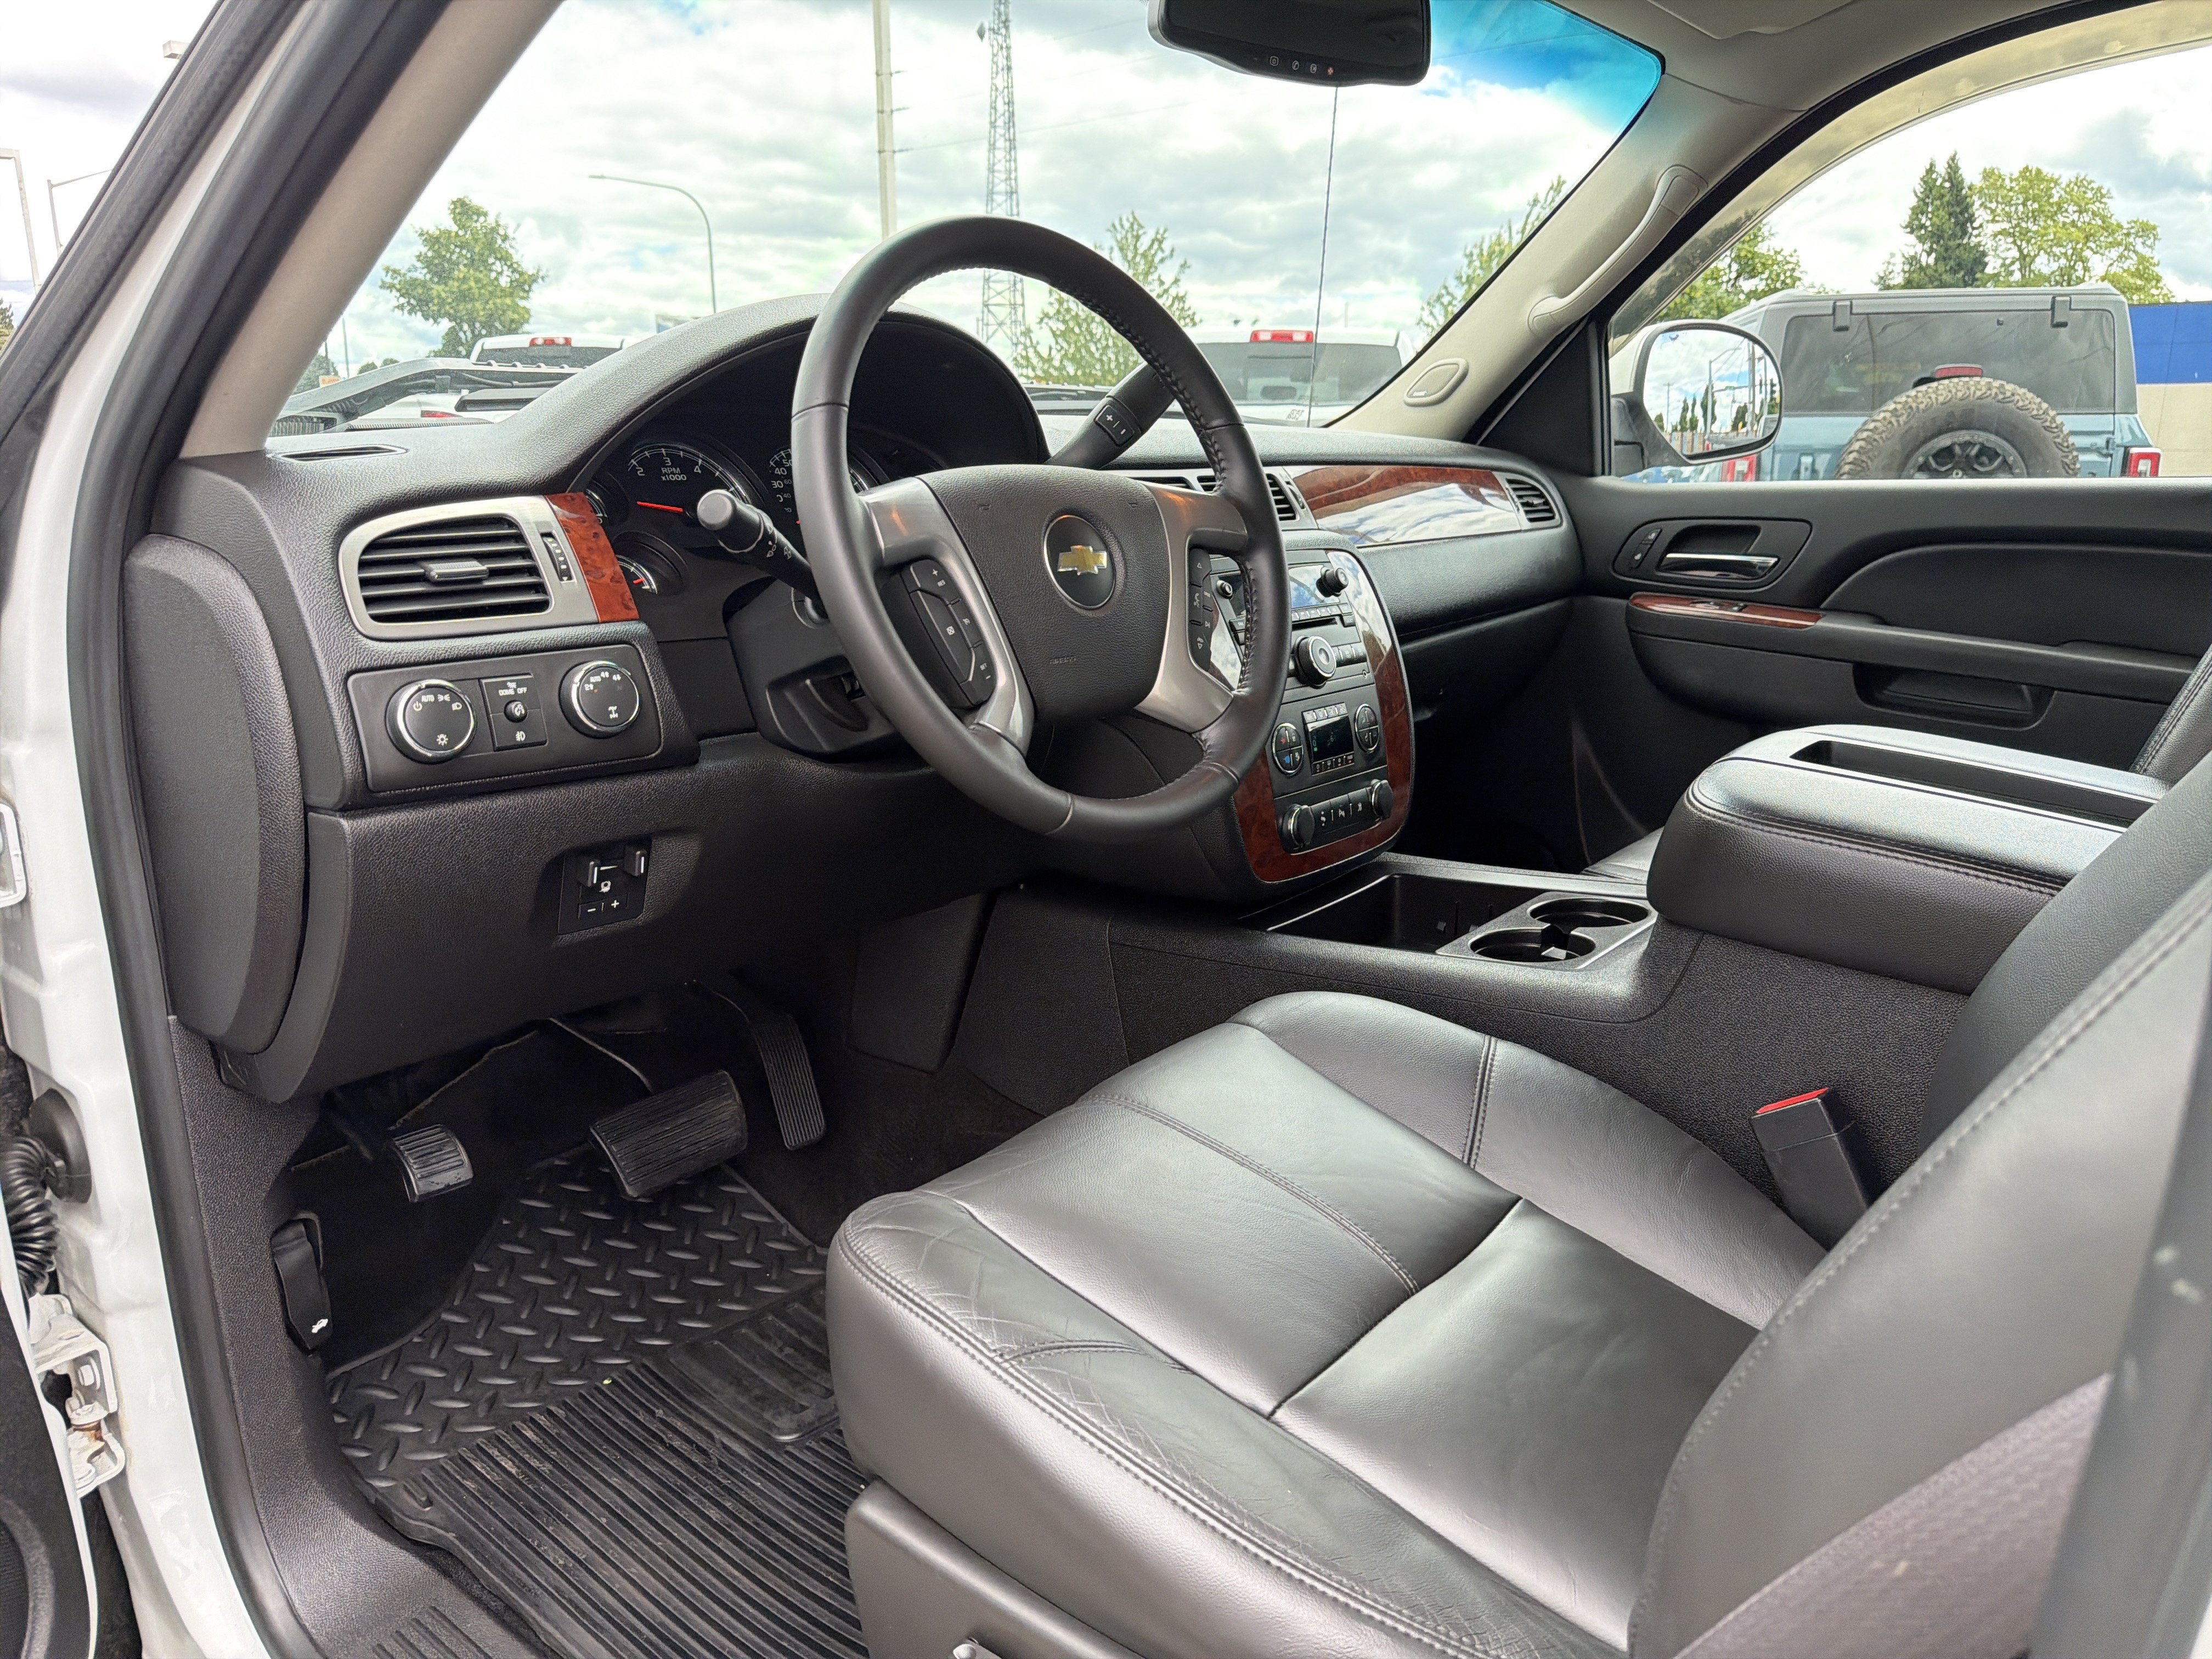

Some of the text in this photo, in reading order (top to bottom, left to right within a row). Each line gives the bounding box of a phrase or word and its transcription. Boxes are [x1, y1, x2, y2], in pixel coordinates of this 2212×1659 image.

[663, 457, 672, 466] 3
[636, 467, 645, 476] 2
[693, 466, 702, 474] 4
